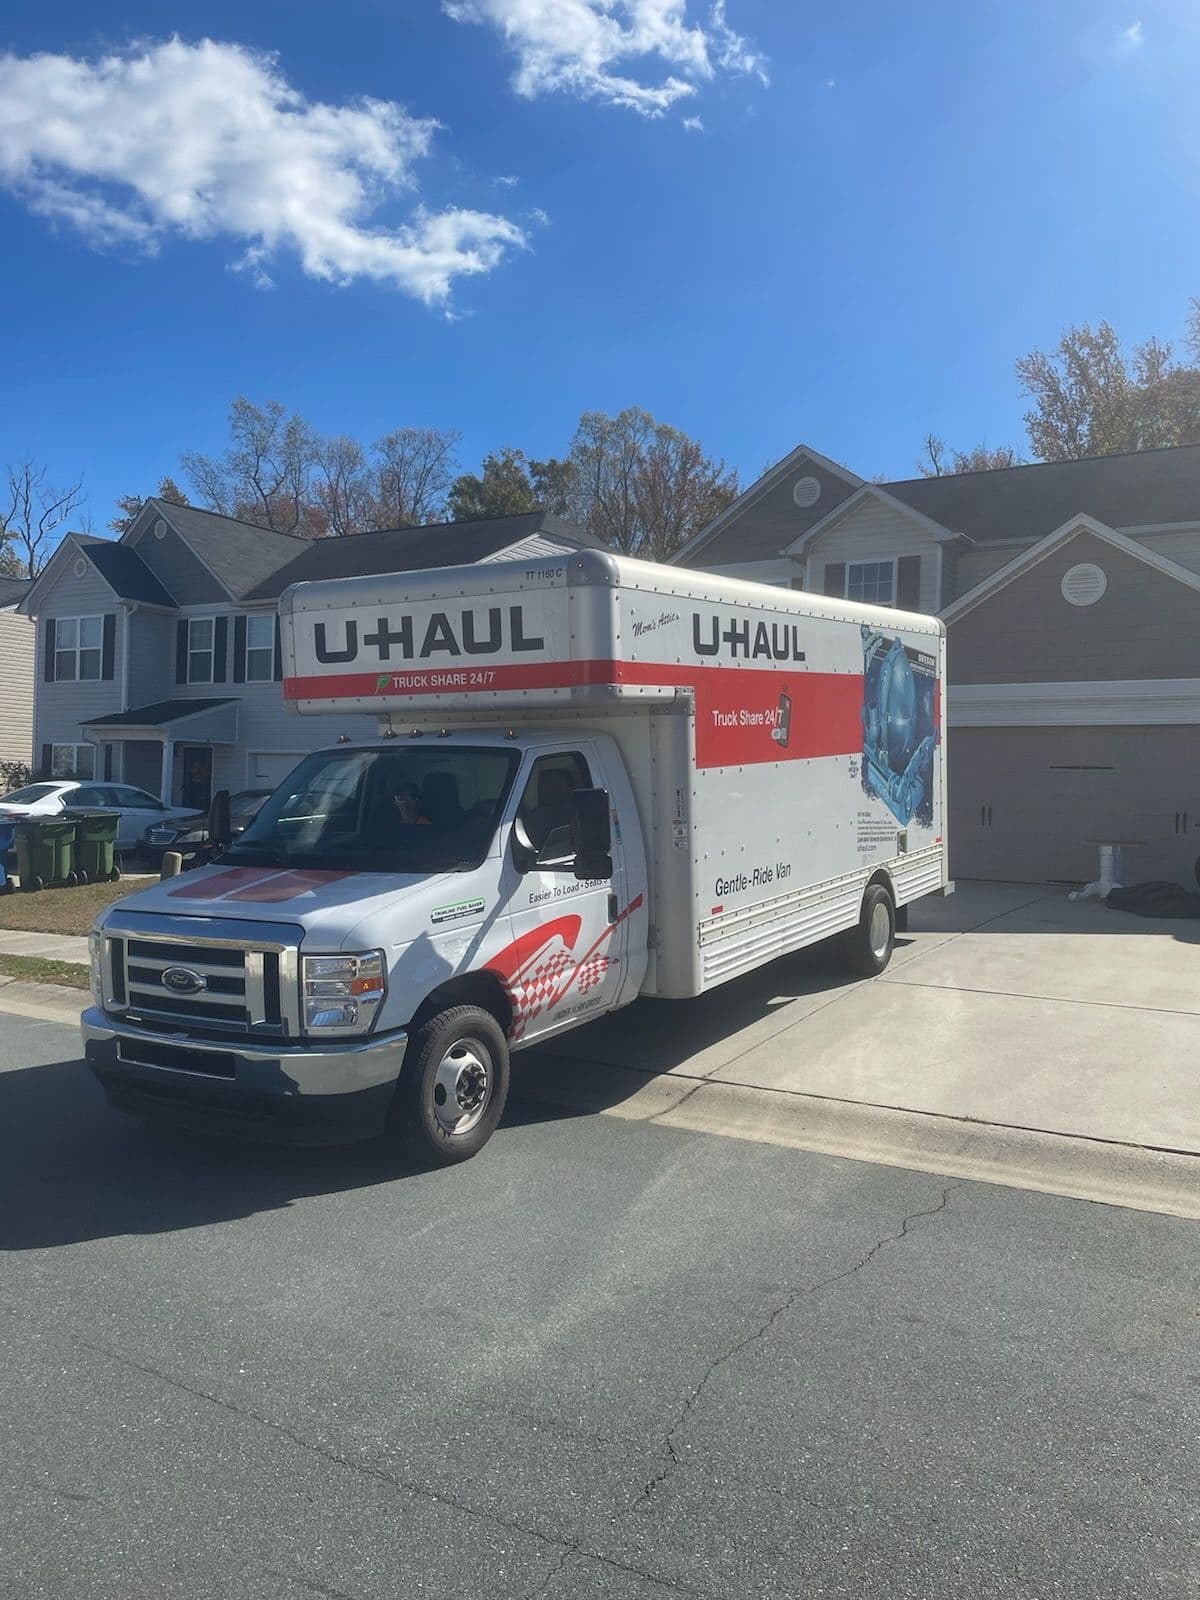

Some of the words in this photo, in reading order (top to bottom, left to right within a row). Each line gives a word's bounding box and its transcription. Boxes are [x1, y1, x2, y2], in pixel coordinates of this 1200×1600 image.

[526, 571, 535, 581] TT
[556, 568, 562, 577] C
[314, 606, 544, 664] U-HAUL
[632, 619, 656, 637] Mom's
[692, 613, 806, 661] U-HAUL
[392, 675, 430, 689] TRUCK
[431, 673, 467, 687] SHARE
[470, 671, 494, 685] 24/7
[712, 710, 738, 726] Truck
[739, 709, 763, 725] Share
[765, 706, 784, 727] 24/7
[715, 866, 773, 896] Gentle-Ride
[775, 863, 792, 879] Van
[529, 891, 552, 904] Easier
[553, 887, 562, 897] To
[562, 882, 579, 895] Load
